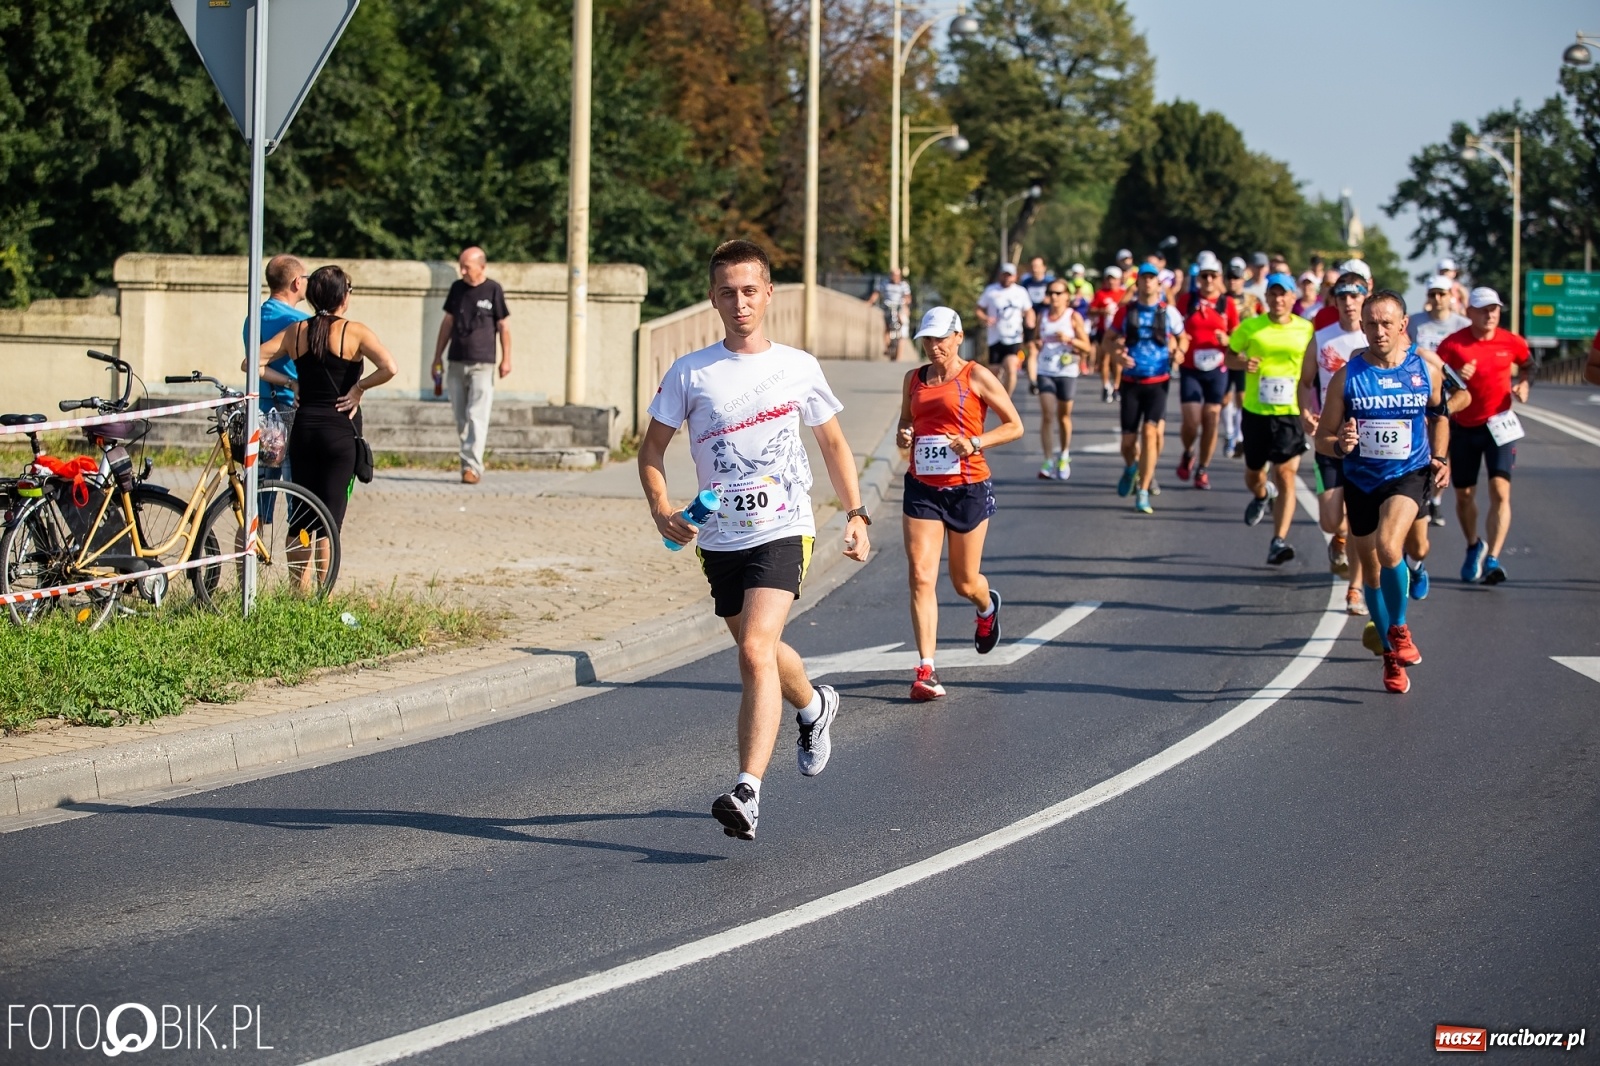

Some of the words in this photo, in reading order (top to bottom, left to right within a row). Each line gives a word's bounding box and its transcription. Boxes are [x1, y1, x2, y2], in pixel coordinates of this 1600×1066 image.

[724, 391, 752, 413] GRYF
[753, 370, 787, 396] KIETRZ
[1273, 385, 1284, 394] 67
[1351, 393, 1428, 411] RUNNERS
[1374, 430, 1398, 444] 163
[924, 446, 947, 459] 354
[733, 491, 769, 512] 230
